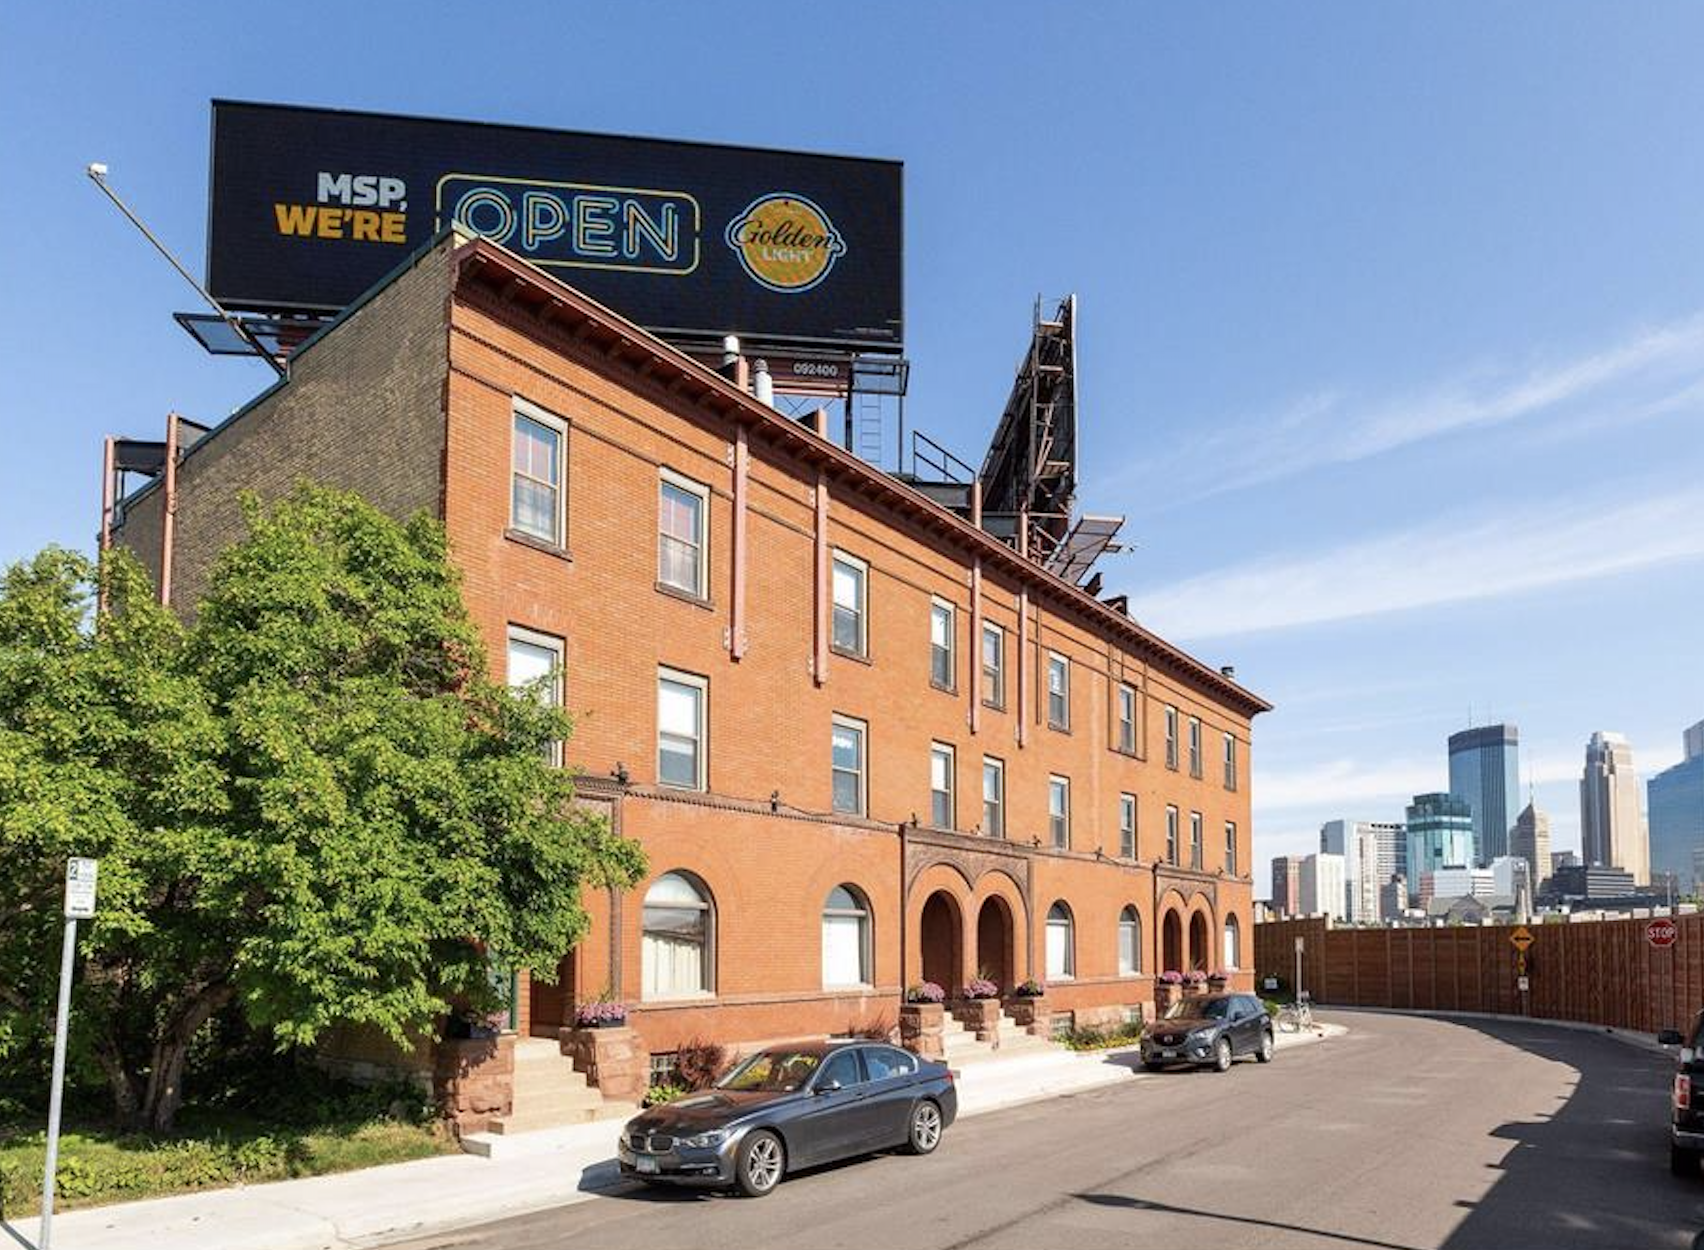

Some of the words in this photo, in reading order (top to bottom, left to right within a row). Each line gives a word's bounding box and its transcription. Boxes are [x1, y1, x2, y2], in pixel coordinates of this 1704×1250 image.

[317, 171, 408, 212] MSP,
[274, 203, 407, 244] WE'RE
[454, 187, 679, 262] OPEN
[734, 220, 839, 250] Golden
[762, 247, 811, 262] LIGHT
[1648, 927, 1675, 939] STOP
